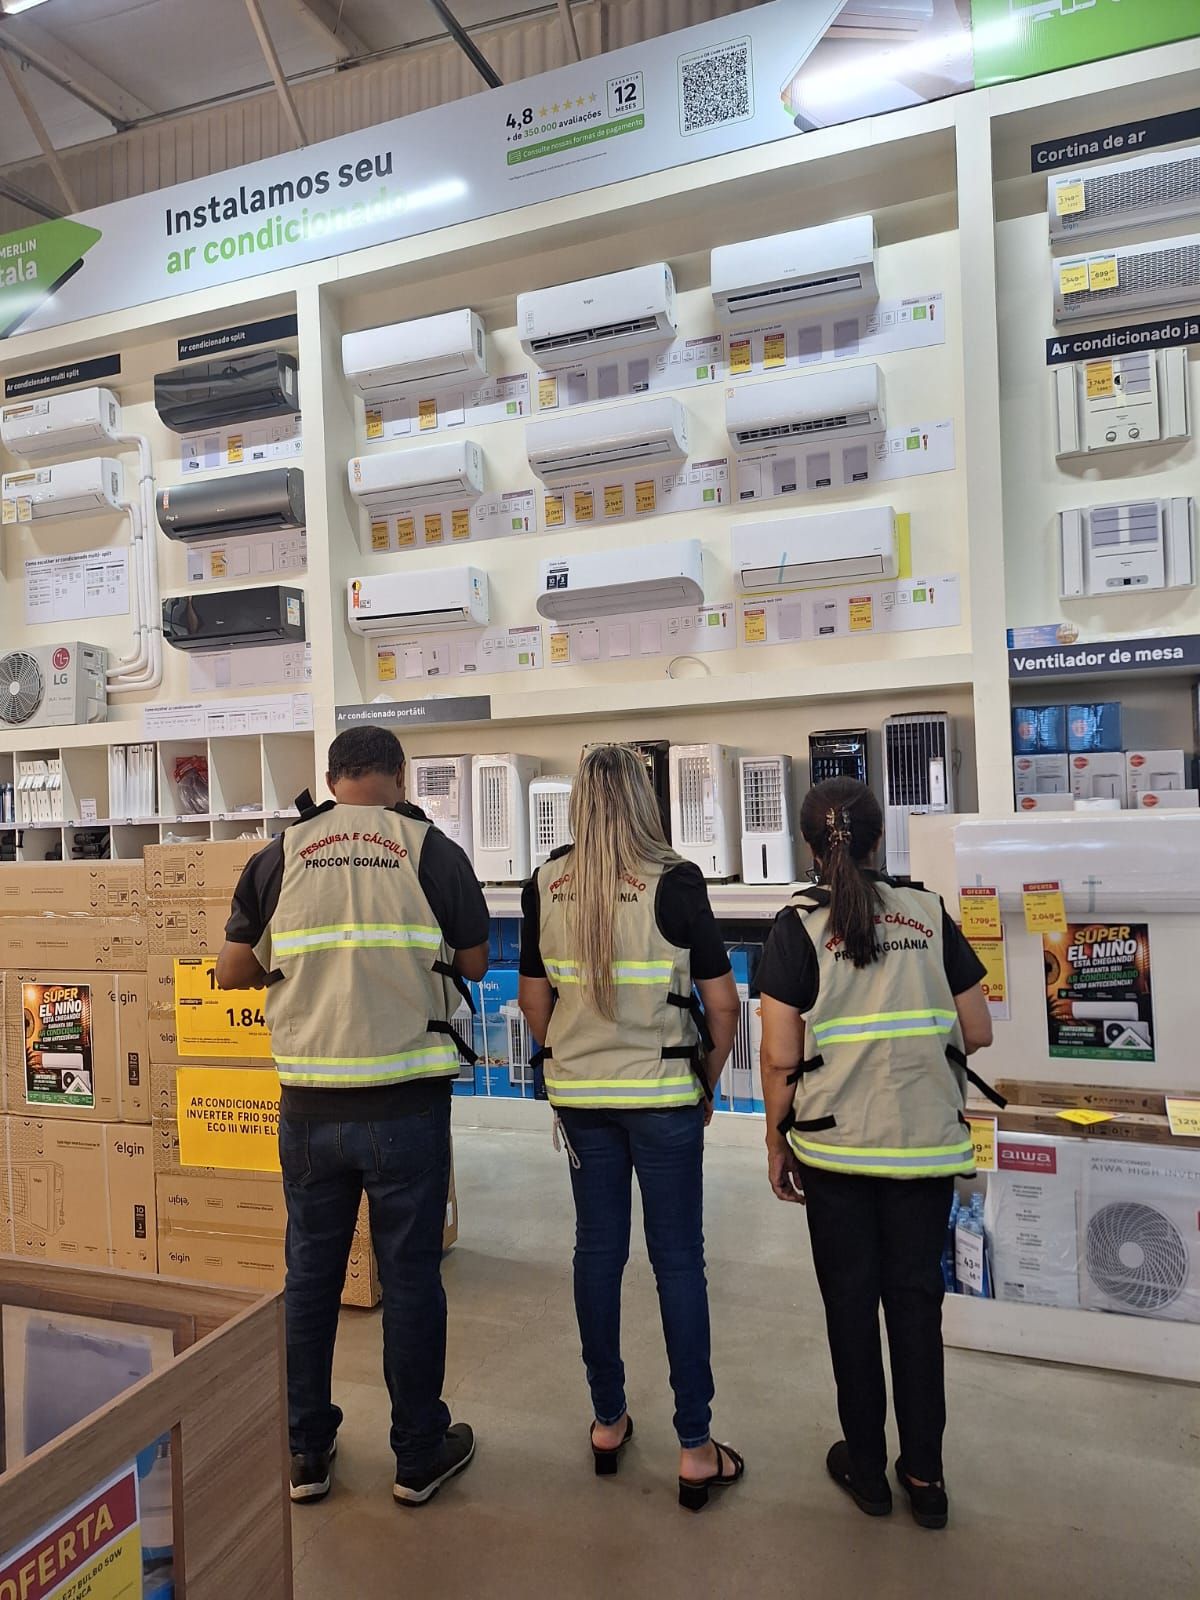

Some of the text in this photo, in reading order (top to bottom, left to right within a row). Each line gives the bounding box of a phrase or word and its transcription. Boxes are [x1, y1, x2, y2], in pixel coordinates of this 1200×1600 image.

[614, 83, 637, 106] 12
[615, 102, 638, 113] MESES
[505, 107, 534, 131] 4,8
[512, 131, 523, 142] de
[558, 108, 602, 128] avaliações
[522, 118, 644, 158] Consulte nossas formas de pagamento
[1036, 130, 1146, 164] Cortina de ar
[165, 151, 393, 237] Instalamos seu
[166, 186, 409, 275] ar condicionado
[180, 332, 246, 353] Ar condicionado split
[1051, 322, 1200, 356] Ar condicionado ja
[6, 368, 79, 392] Ar condicionado multi split
[1013, 646, 1184, 671] Ventilador de mesa
[53, 673, 69, 686] LG
[337, 706, 426, 721] Ar condicionado portátil
[299, 831, 409, 860] PESQUISA E CÁLCULO
[305, 856, 400, 869] PROCON GOIÂNIA
[549, 873, 647, 894] PESQ CULO
[884, 912, 934, 939] CÁLCULO
[1074, 926, 1131, 945] SUPER
[883, 937, 929, 952] GOIÂNIA
[1067, 938, 1137, 961] EL NIÑO
[1092, 955, 1135, 967] CHEGANDO!
[1067, 970, 1139, 984] AR CONDICIONADO
[1081, 966, 1110, 974] GARANTA
[1073, 982, 1087, 990] COM
[43, 987, 79, 1004] SUPER
[107, 990, 137, 1006] egin
[39, 999, 83, 1018] EL NIÑO
[190, 1097, 281, 1111] AR CONDICIONADO
[186, 1109, 234, 1121] INVERTER
[237, 1112, 260, 1122] FRIO
[207, 1122, 280, 1135] ECO III WIFI EL
[114, 1140, 145, 1157] elgin
[1001, 1149, 1052, 1163] aiwa
[1091, 1163, 1123, 1173] AIWA
[1128, 1167, 1160, 1177] HIGH
[168, 1194, 191, 1206] elgin
[168, 1251, 191, 1264] elgin
[963, 1257, 974, 1269] 43
[0, 1503, 115, 1600] OFERTA
[77, 1562, 104, 1588] BULBO
[103, 1546, 123, 1568] 50W
